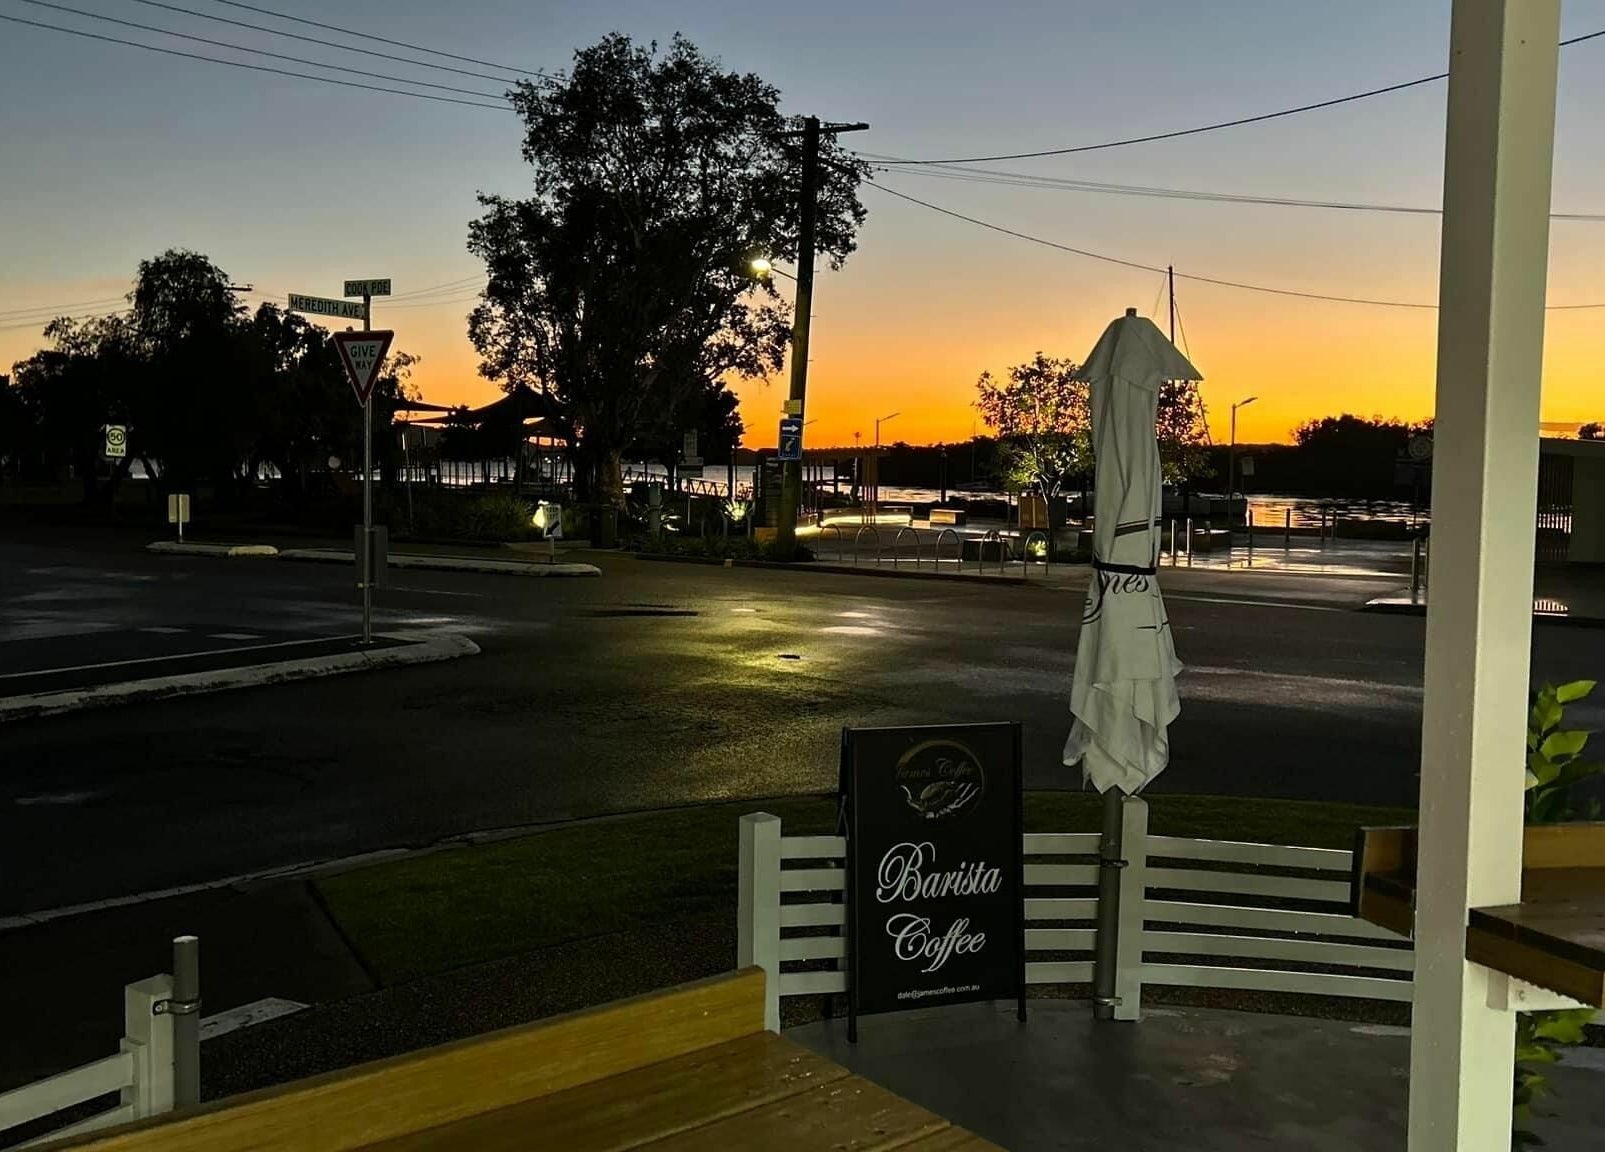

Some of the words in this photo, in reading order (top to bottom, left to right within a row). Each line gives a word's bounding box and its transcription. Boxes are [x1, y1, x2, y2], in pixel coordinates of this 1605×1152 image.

[346, 282, 367, 295] COOK
[371, 281, 388, 295] PDE
[291, 297, 339, 314] MEREDITH
[342, 304, 359, 317] AVE
[350, 345, 376, 358] GIVE
[355, 361, 371, 369] WAY
[110, 432, 122, 441] 50
[876, 842, 1002, 904] Barista
[886, 913, 987, 973] Coffee
